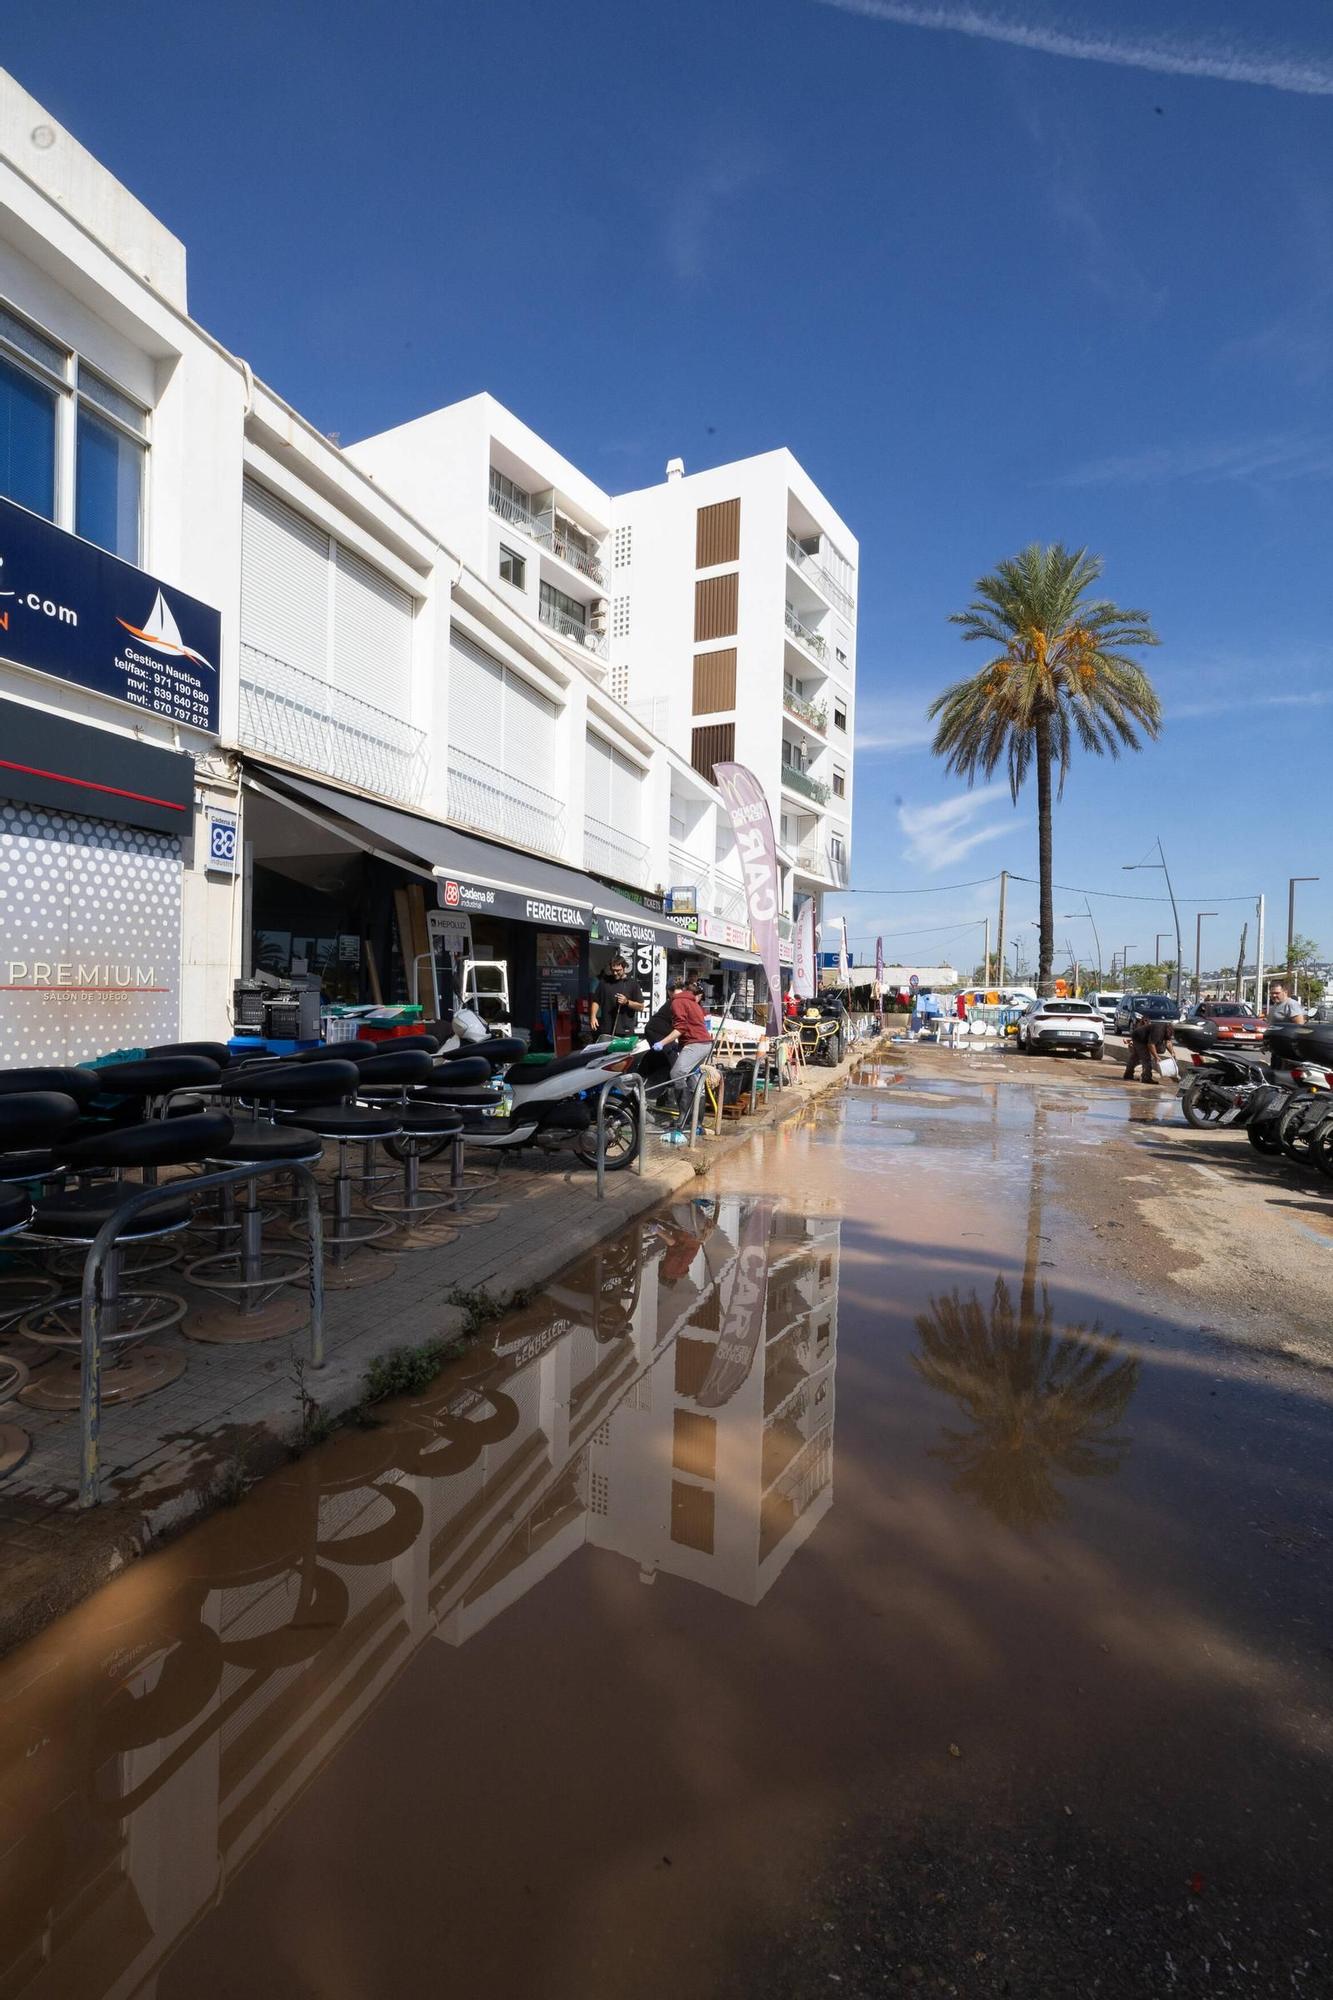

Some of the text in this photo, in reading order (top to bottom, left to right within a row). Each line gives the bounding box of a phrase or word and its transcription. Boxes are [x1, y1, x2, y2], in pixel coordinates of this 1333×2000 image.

[18, 593, 78, 627] .com
[124, 647, 201, 688] Gestion Nautica
[154, 673, 171, 688] 971
[174, 682, 191, 695] 190
[192, 689, 209, 703] 680
[154, 686, 171, 701] 639
[174, 694, 191, 708] 640
[192, 702, 209, 715] 278
[153, 700, 171, 714] 670
[174, 707, 191, 720] 797
[192, 714, 209, 728] 873
[459, 885, 486, 902] Cadena
[486, 891, 495, 904] 88
[460, 900, 482, 910] industrial
[526, 900, 585, 926] FERRETERIA
[604, 919, 632, 939] TORRES
[632, 926, 656, 942] GUASCH
[637, 942, 652, 975] CA
[8, 961, 156, 987] PREMIUM
[81, 993, 94, 1001] DE
[98, 992, 129, 1001] JUEGO
